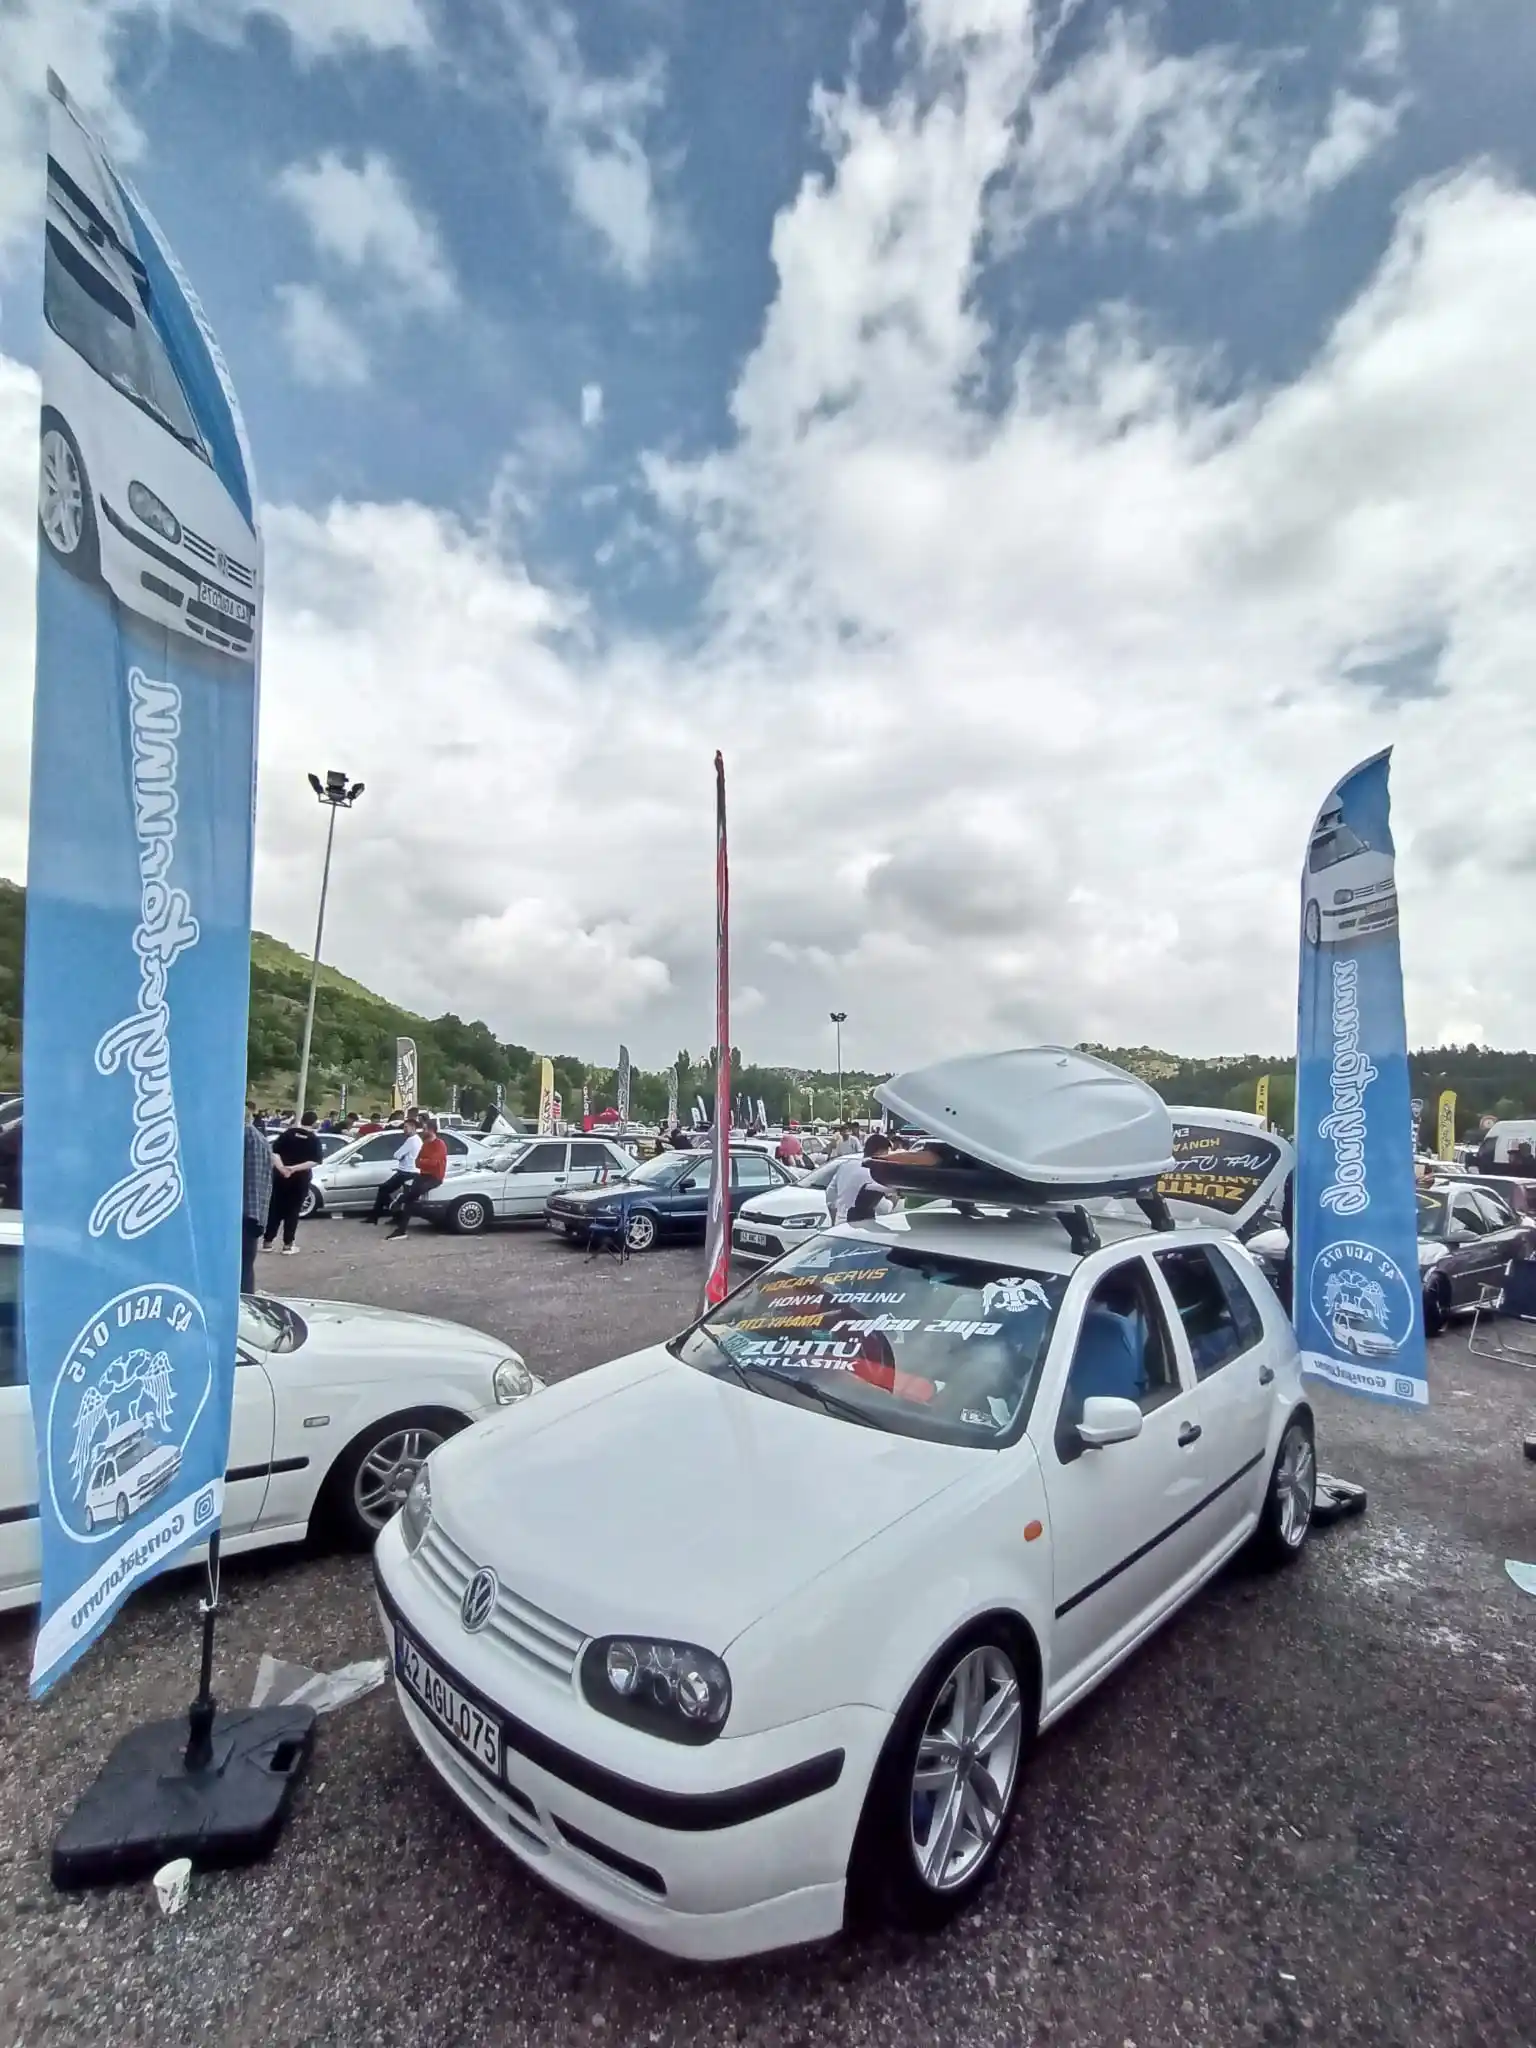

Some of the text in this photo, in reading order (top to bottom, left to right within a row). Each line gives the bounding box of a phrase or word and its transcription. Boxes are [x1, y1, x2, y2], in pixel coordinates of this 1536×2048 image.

[1173, 1138, 1220, 1152] KONYA
[768, 1292, 906, 1308] KONYA TORUNU
[740, 1335, 862, 1358] ZÜHTÜ
[403, 1643, 496, 1765] 42 AGU 075
